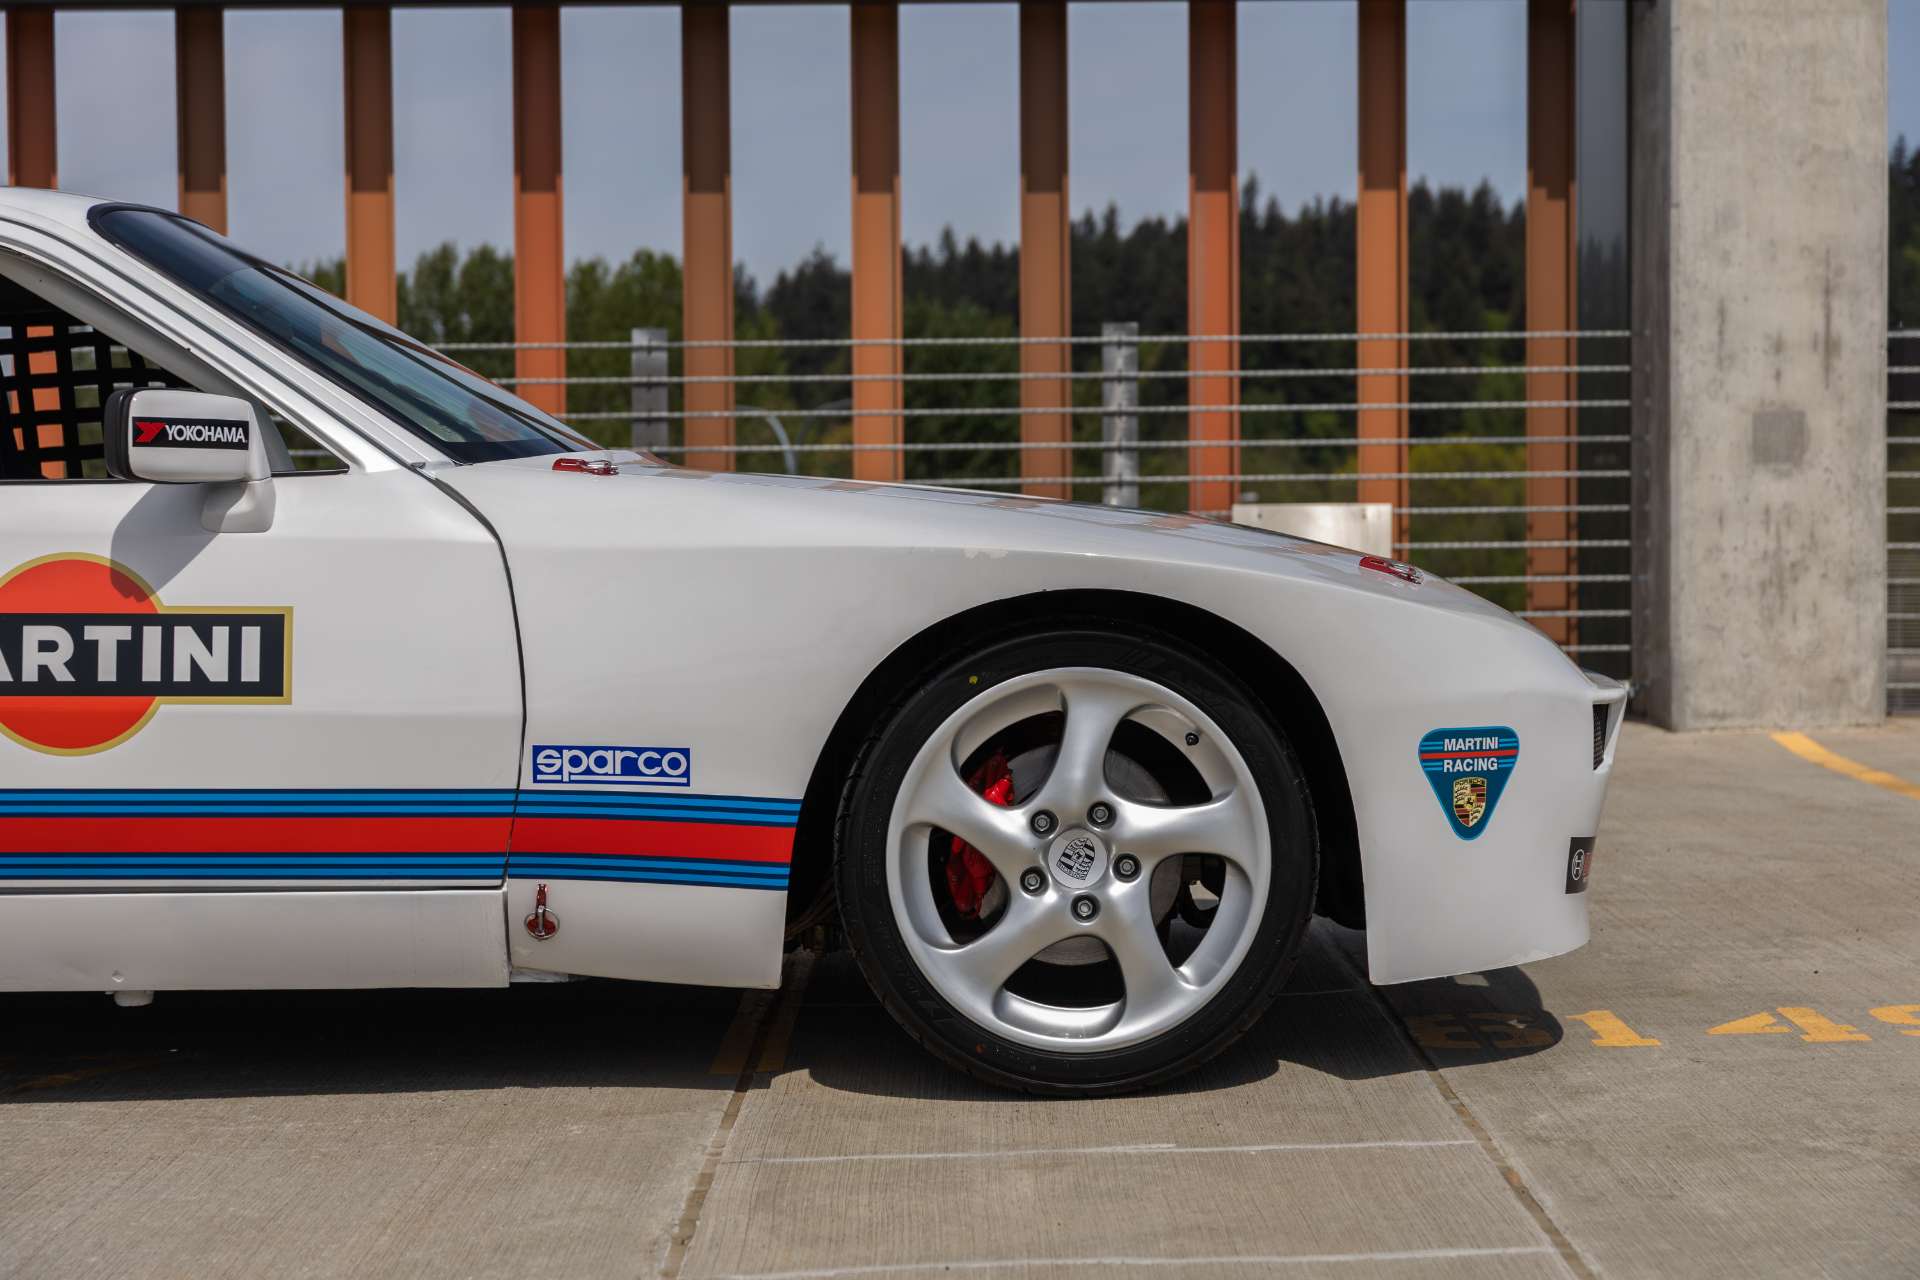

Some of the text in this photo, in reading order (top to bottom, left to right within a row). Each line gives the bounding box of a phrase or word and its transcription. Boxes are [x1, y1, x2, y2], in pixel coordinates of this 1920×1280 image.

[165, 424, 246, 443] YOKOHAMA
[0, 625, 261, 682] RTINI
[1444, 736, 1499, 752] MARTINI
[536, 748, 688, 782] sparco
[1443, 757, 1499, 773] RACING
